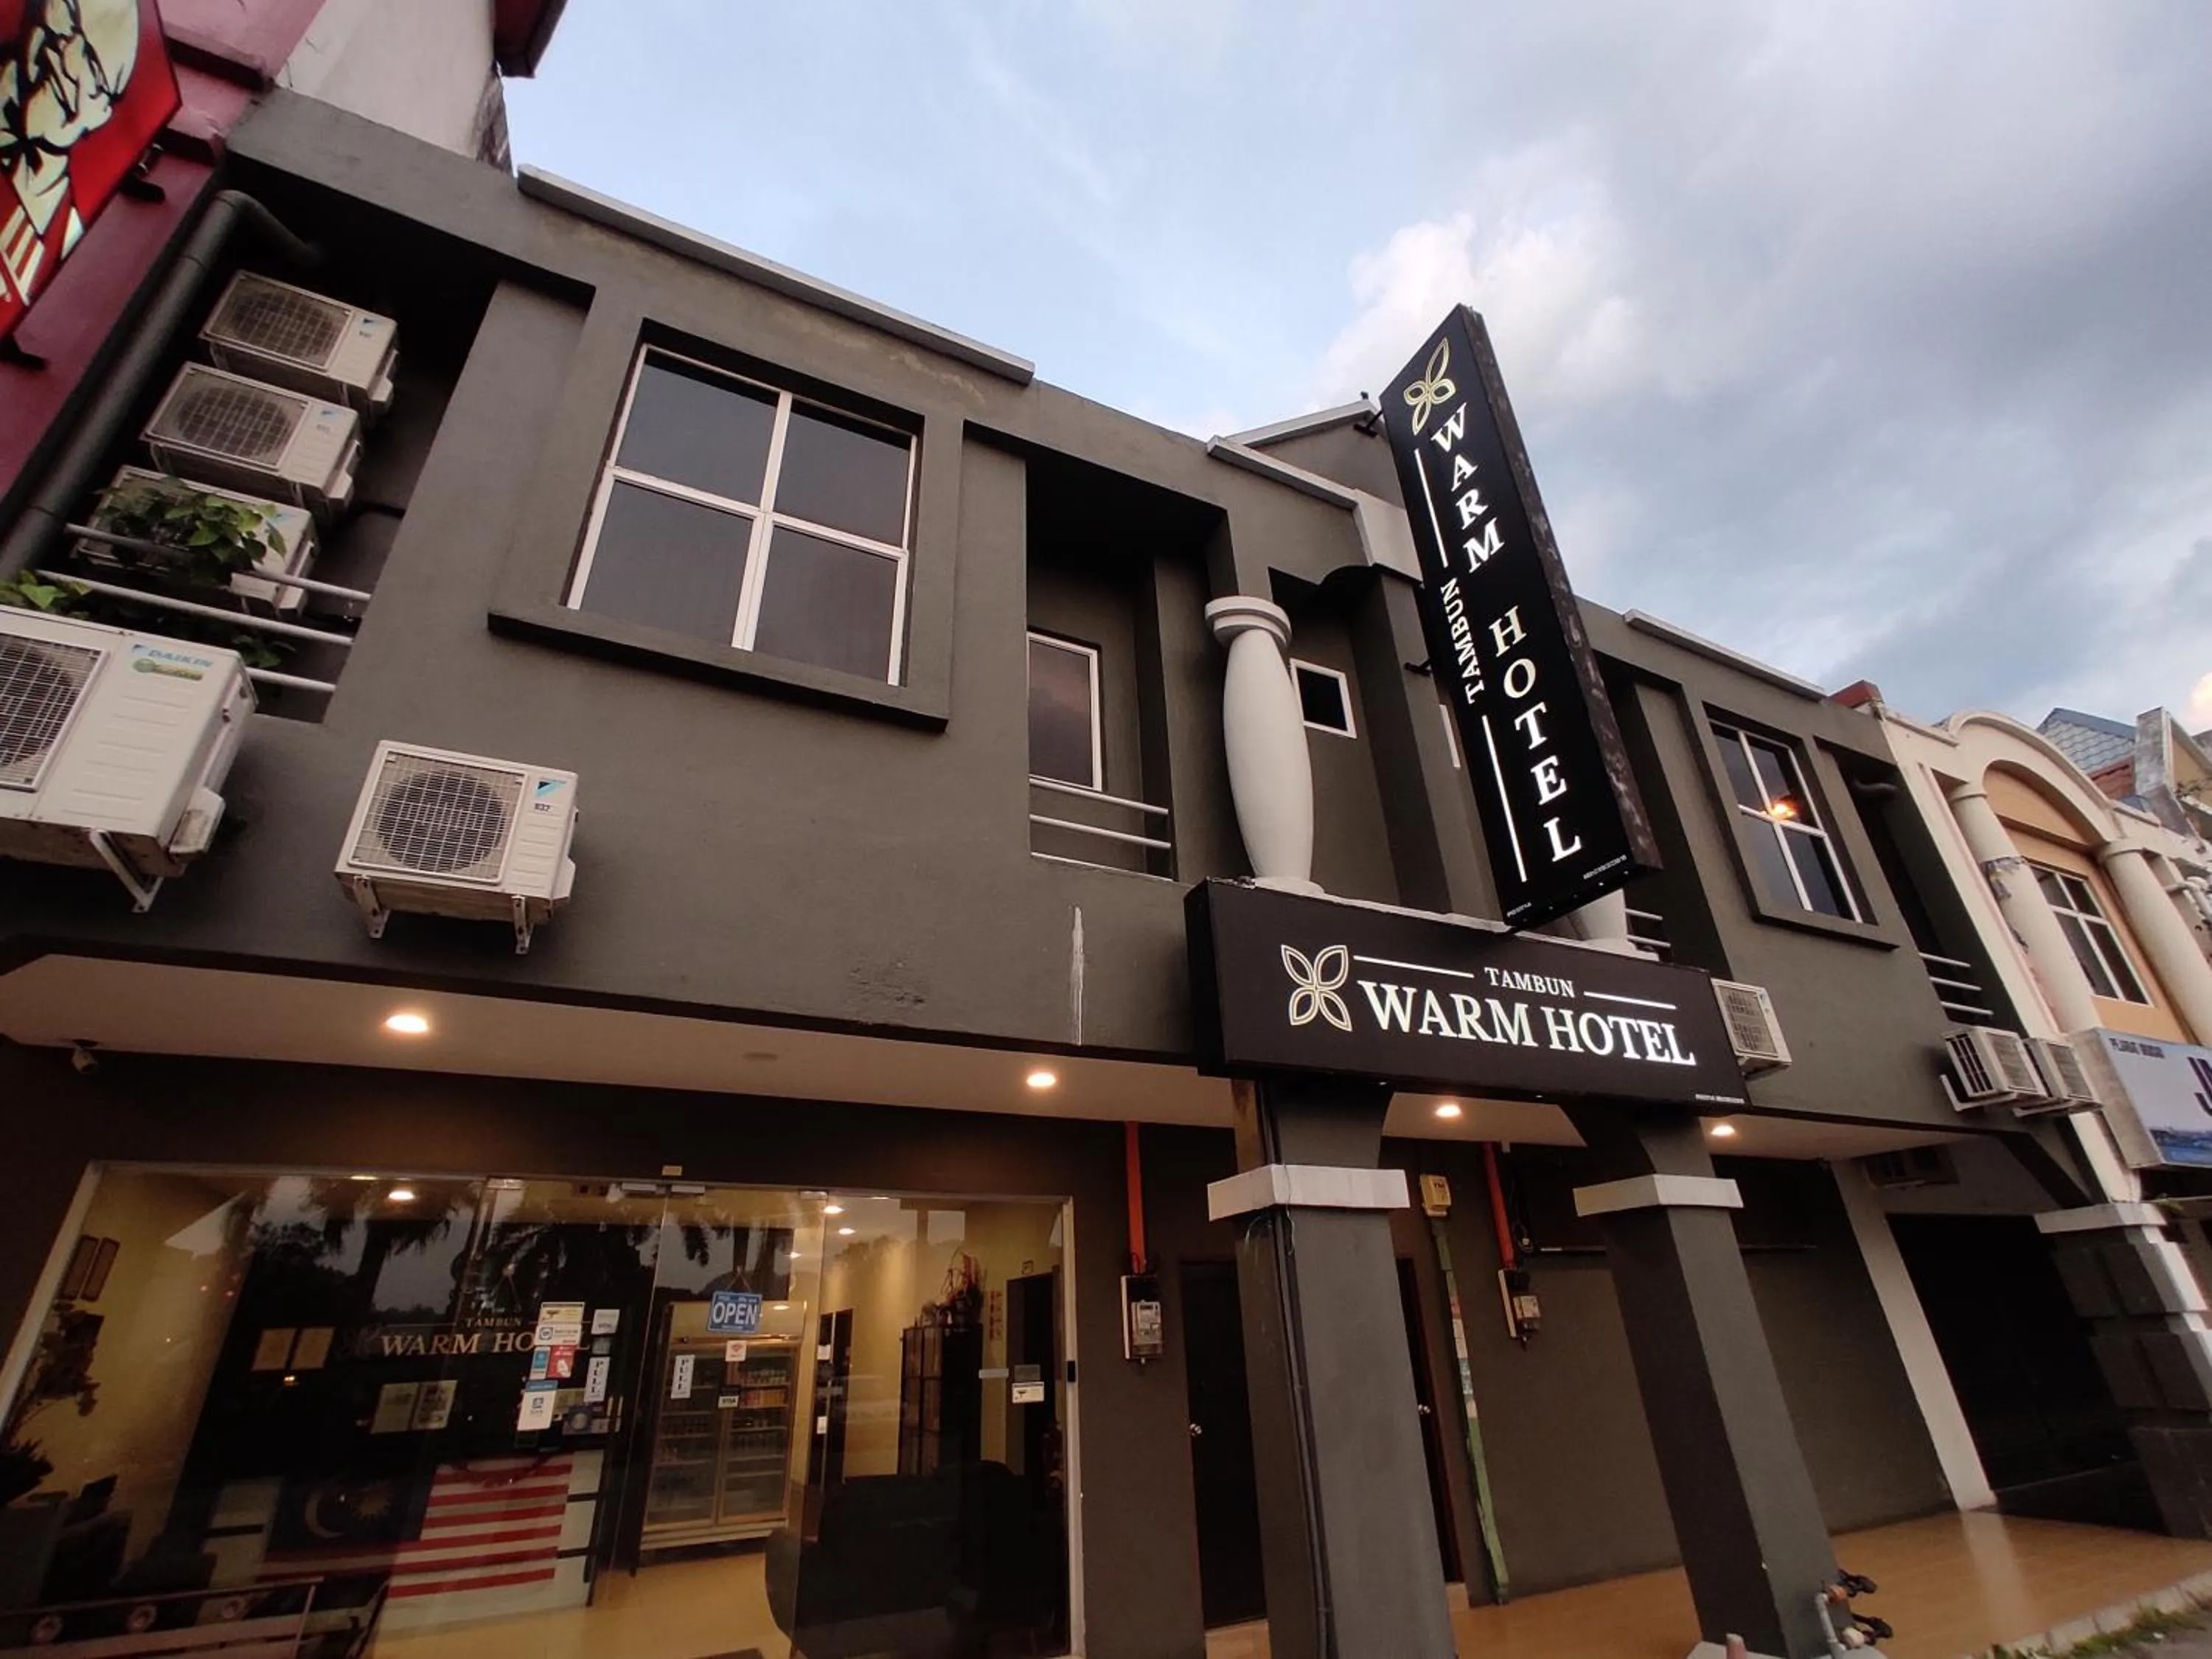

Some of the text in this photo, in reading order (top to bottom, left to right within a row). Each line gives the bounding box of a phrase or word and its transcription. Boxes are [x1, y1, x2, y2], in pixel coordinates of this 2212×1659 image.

[1430, 402, 1582, 863] WARM HOTEL
[1440, 577, 1486, 705] TAMBUN
[1484, 967, 1576, 998] TAMBUN
[1356, 979, 1697, 1066] WARM HOTEL
[465, 1317, 522, 1327] TAMBUN
[712, 1301, 758, 1326] OPEN
[381, 1332, 481, 1357] WARM
